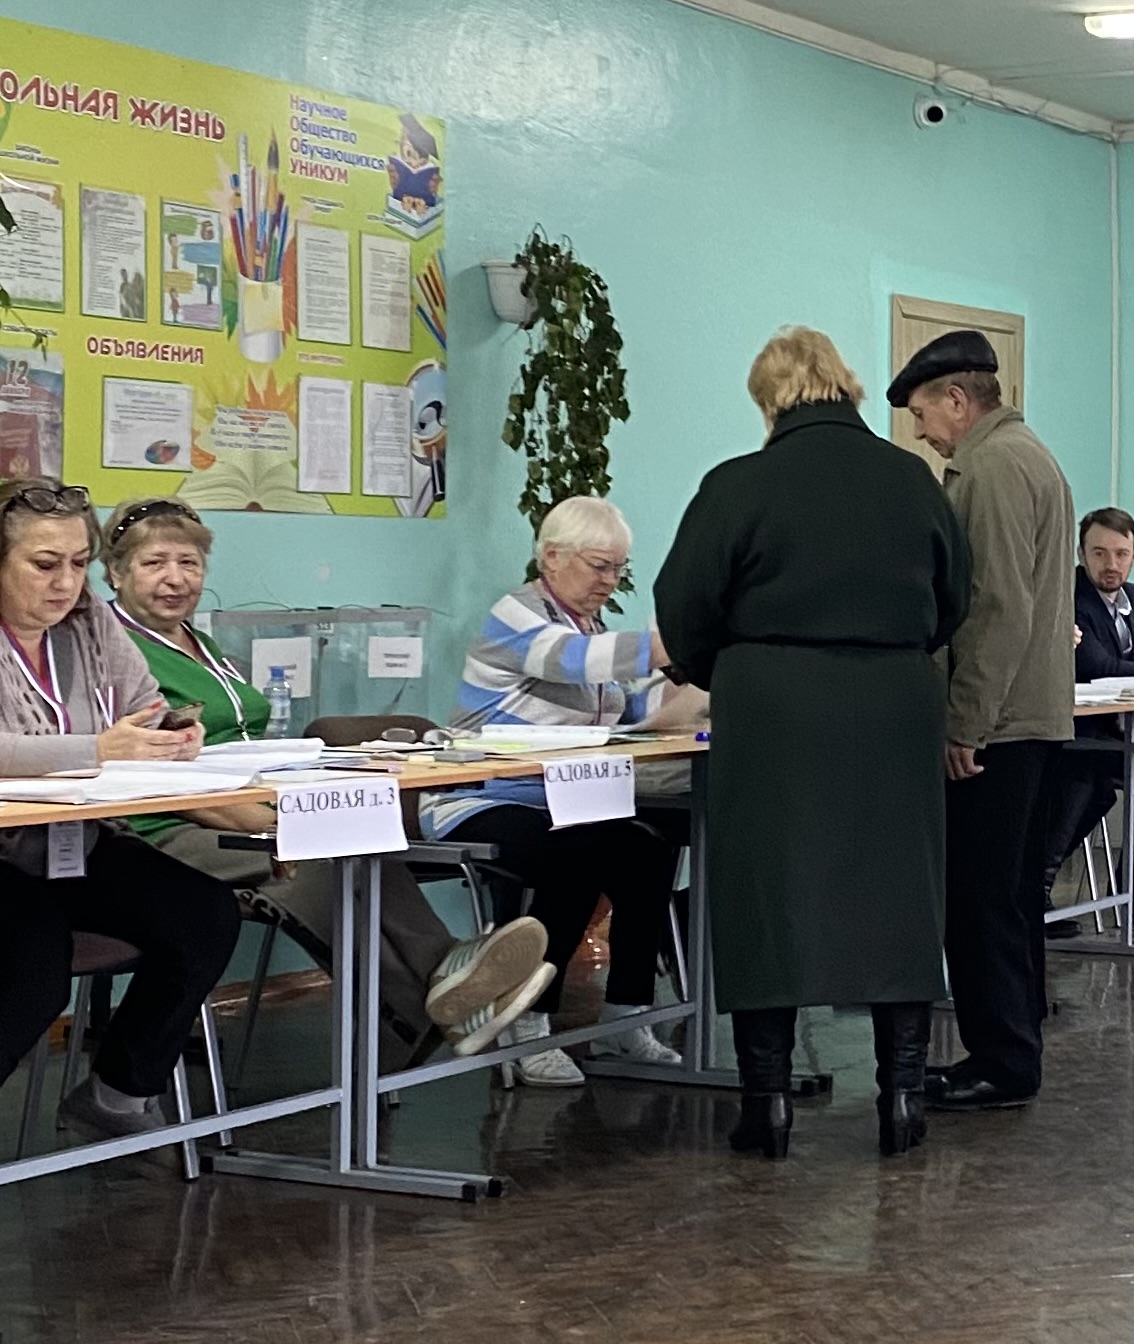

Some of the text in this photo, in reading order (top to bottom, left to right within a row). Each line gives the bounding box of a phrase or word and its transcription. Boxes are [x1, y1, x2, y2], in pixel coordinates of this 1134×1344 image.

[128, 96, 226, 142] ЖИЗНЬ
[289, 94, 348, 122] Научное
[290, 116, 358, 145] Общество
[290, 137, 386, 171] Обучающихся
[290, 158, 348, 184] УНИКУМ
[86, 336, 205, 365] ОБЪЯВЛЕНИЯ
[7, 359, 29, 385] 12
[545, 760, 632, 784] САДОВАЯ д. 5
[279, 786, 396, 815] САДОВАЯ д. 3
